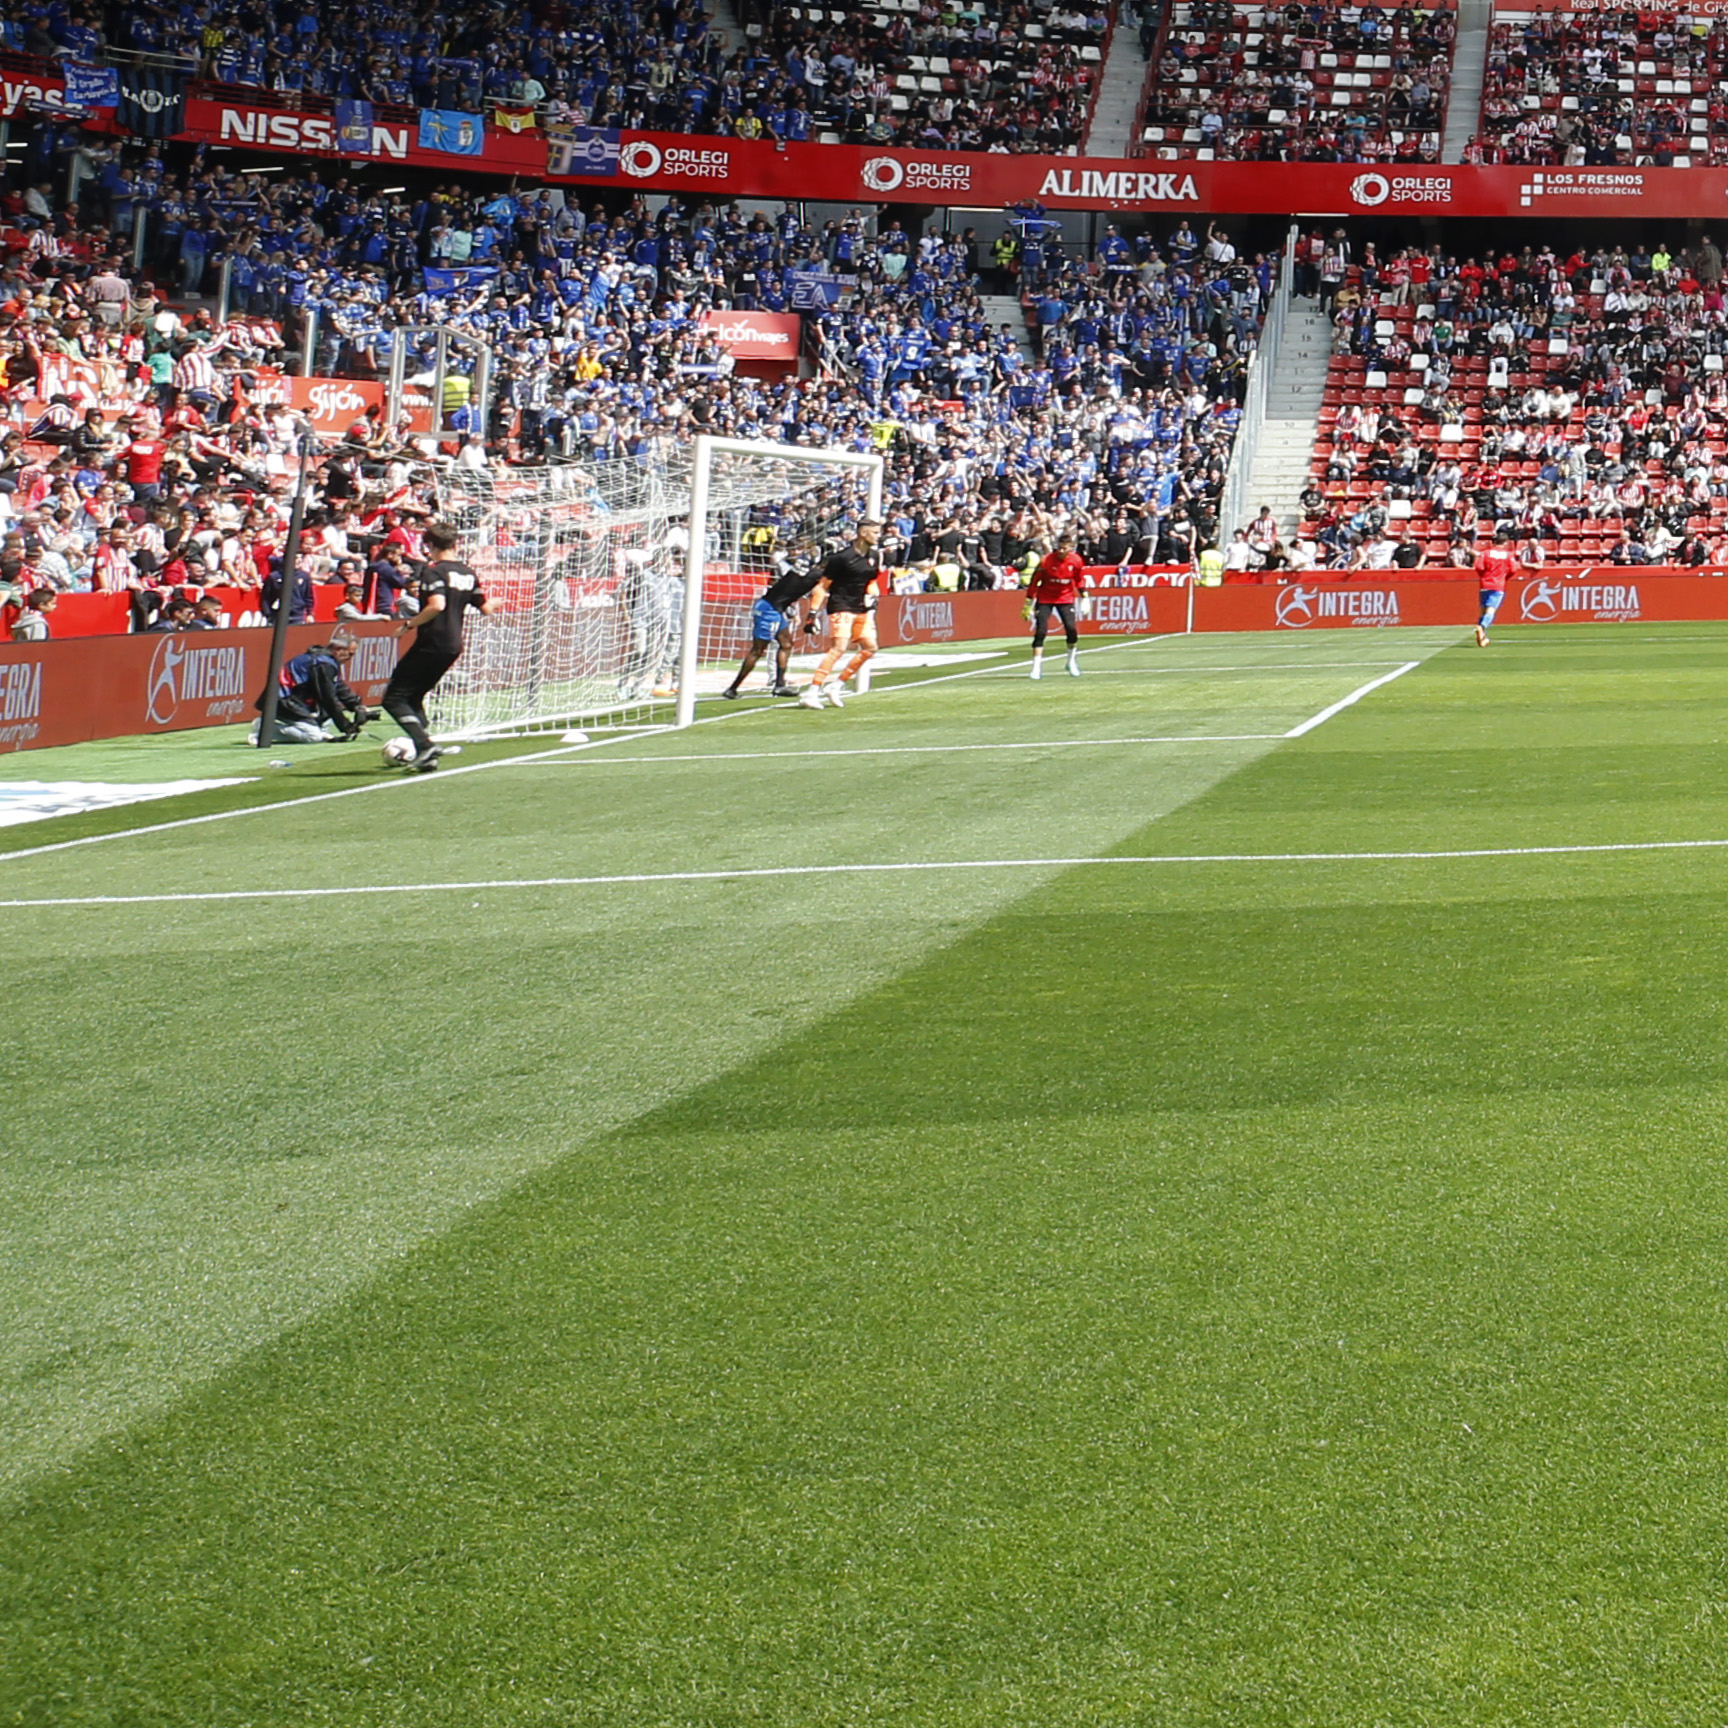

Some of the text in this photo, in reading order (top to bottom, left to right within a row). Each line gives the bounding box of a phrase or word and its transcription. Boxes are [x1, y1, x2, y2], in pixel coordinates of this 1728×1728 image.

[220, 109, 408, 159] NISSN
[664, 148, 728, 165] ORLEGI
[663, 161, 728, 179] SPORTS
[906, 162, 971, 177] ORLEGI
[906, 174, 971, 191] SPORTS
[1039, 170, 1198, 200] ALIMERKA
[1393, 177, 1452, 191] ORLEGI
[1547, 174, 1643, 186] LOS FRESNOS
[1392, 189, 1452, 203] SPORTS
[1547, 186, 1643, 196] CENTRO COMERCIAL
[1318, 590, 1398, 617] INTEGRA
[1562, 585, 1639, 611] INTEGRA
[181, 646, 245, 700] INTEGRA
